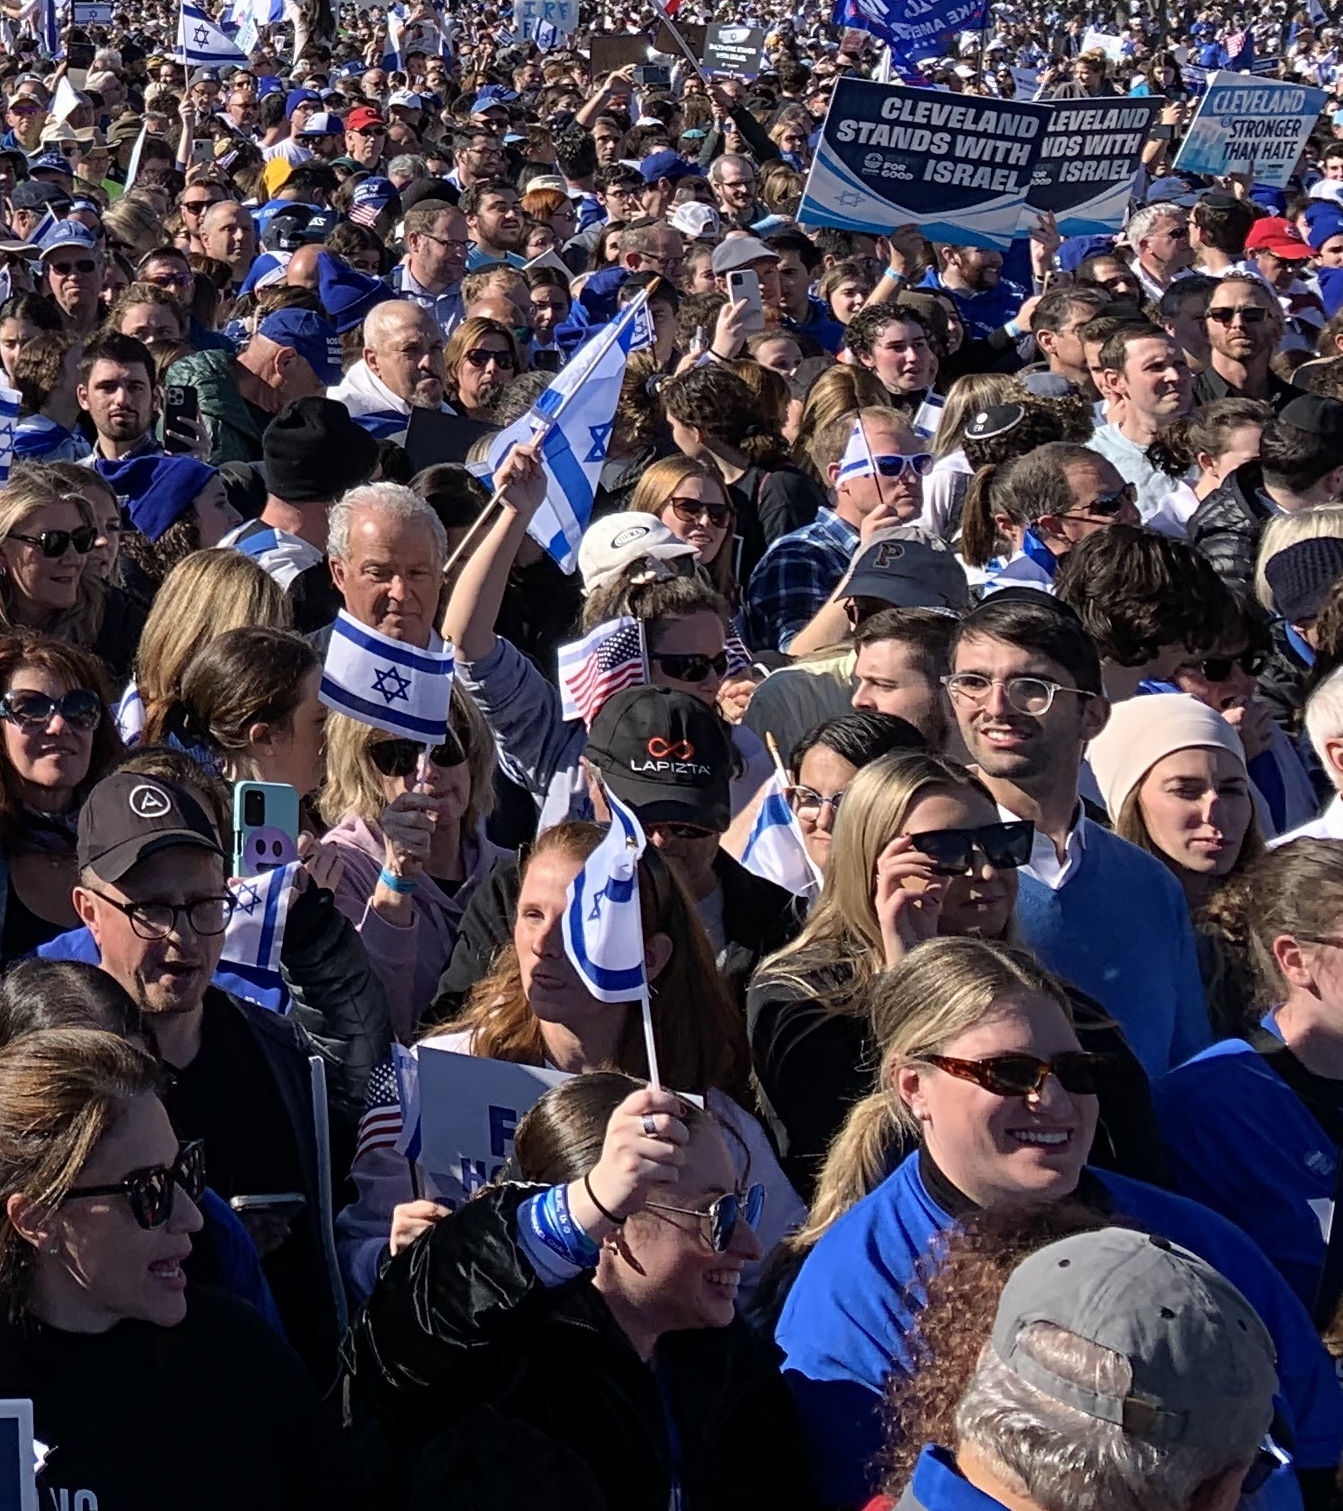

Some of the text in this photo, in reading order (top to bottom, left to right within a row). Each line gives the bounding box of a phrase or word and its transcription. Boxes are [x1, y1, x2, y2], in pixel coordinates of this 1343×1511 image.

[1212, 89, 1307, 113] CLEVELAND
[881, 97, 1040, 138] CLEVELAND
[1046, 107, 1151, 132] LEVELAND
[1229, 119, 1302, 139] STRONGER
[836, 119, 1033, 166] STANDS WITH
[1040, 134, 1142, 158] NDS WITH
[1221, 141, 1298, 161] THAN HATE
[881, 170, 914, 181] GOOD
[883, 161, 907, 172] FOR
[923, 159, 1020, 194] ISRAEL
[1031, 170, 1048, 178] OR
[1059, 159, 1132, 184] ISRAEL
[873, 542, 905, 568] P
[630, 759, 711, 776] LAPIZTA
